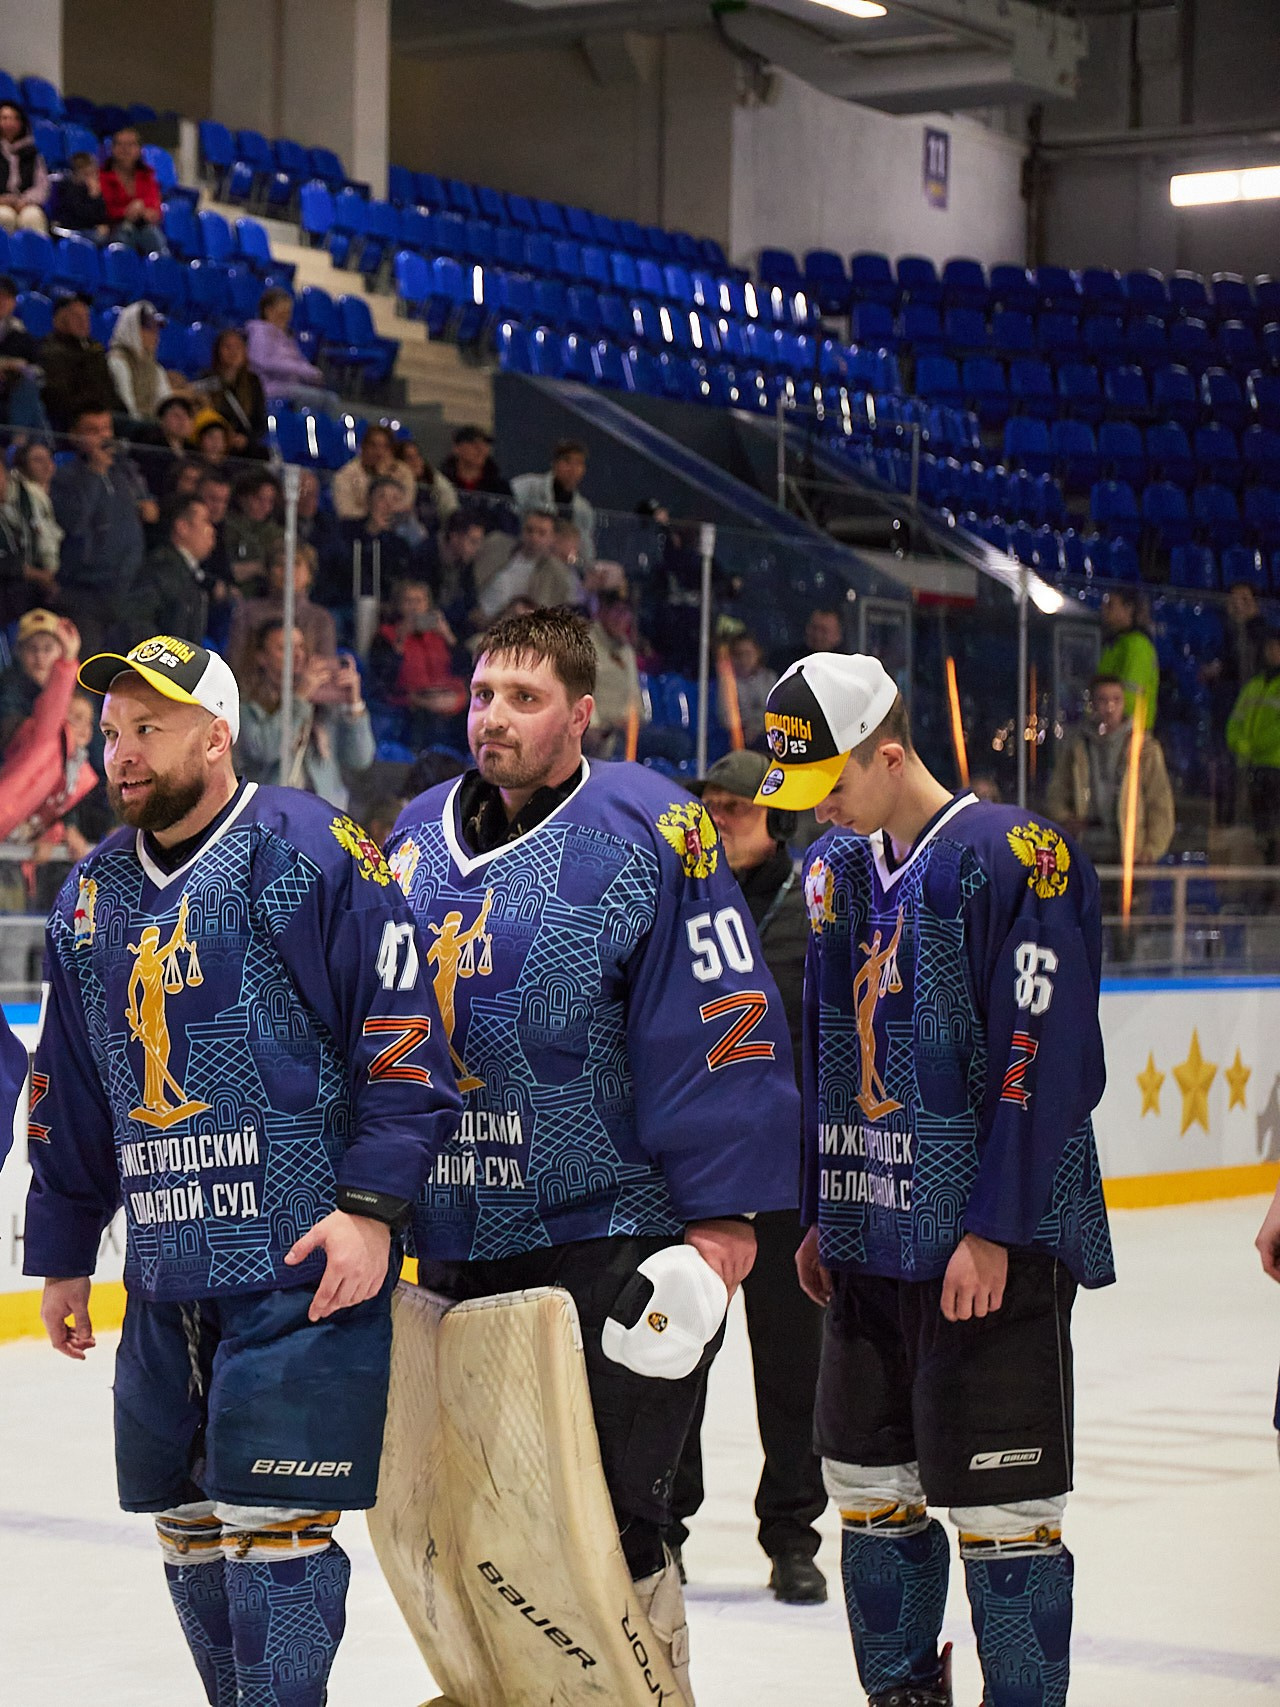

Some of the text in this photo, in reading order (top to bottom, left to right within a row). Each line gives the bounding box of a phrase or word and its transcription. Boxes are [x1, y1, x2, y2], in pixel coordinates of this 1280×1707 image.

[158, 652, 180, 668] 25
[789, 740, 808, 754] 25
[375, 920, 419, 990] 47
[685, 906, 754, 983] 50
[1013, 940, 1059, 1016] 86
[363, 1016, 433, 1088] Z
[699, 990, 775, 1072] Z
[212, 1181, 259, 1219] СУД
[485, 1156, 525, 1189] СУД
[251, 1459, 352, 1477] BAUER
[477, 1561, 596, 1669] BAUER
